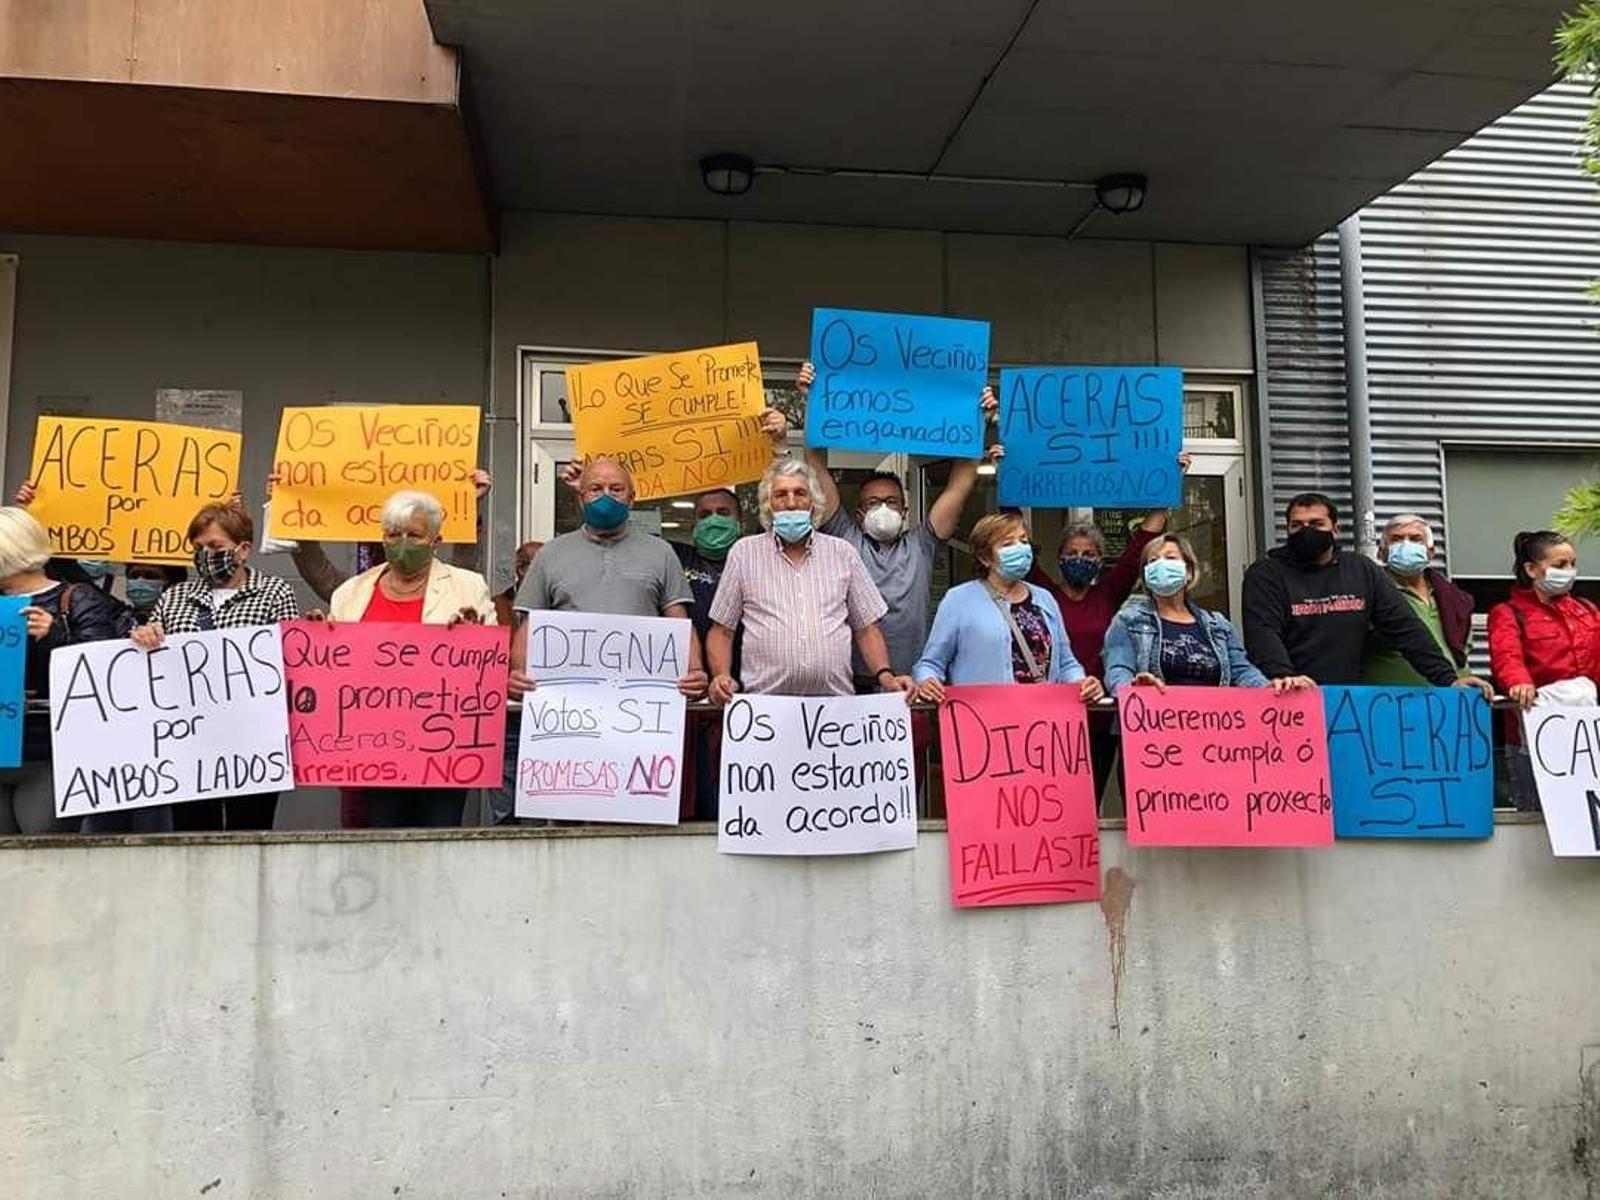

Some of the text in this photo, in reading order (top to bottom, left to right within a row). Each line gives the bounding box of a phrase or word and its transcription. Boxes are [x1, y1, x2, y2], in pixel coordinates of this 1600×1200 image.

[820, 319, 986, 372] Os Veciños
[614, 372, 663, 399] Que
[668, 362, 694, 390] Se
[1004, 372, 1164, 436] ACERAS
[286, 412, 473, 452] Os Veciños
[622, 401, 656, 426] SE
[34, 424, 232, 498] ACERAS
[276, 450, 468, 487] non estamos
[107, 494, 147, 525] por
[281, 498, 327, 529] da
[48, 524, 115, 552] MBOS
[282, 627, 508, 684] Que se cumpla
[531, 625, 680, 677] DIGNA
[55, 629, 282, 731] ACERAS
[338, 677, 502, 739] prometido
[611, 698, 673, 734] SI
[726, 699, 907, 750] Os Veciños
[1123, 692, 1304, 743] Queremos que
[1327, 690, 1491, 775] ACERAS
[153, 715, 204, 758] por
[419, 713, 497, 753] SI
[946, 699, 1090, 783] DIGNA
[1141, 744, 1183, 768] se
[61, 733, 290, 812] AMBOS LADOS!
[422, 753, 485, 785] NO
[519, 754, 676, 791] PROMESAS NO
[728, 752, 909, 794] non estamos
[725, 785, 911, 838] da acordo!!
[996, 784, 1063, 829] NOS
[1136, 778, 1331, 831] primeiro proxecto
[1360, 777, 1465, 829] SI
[961, 834, 1099, 883] FALLASTE
